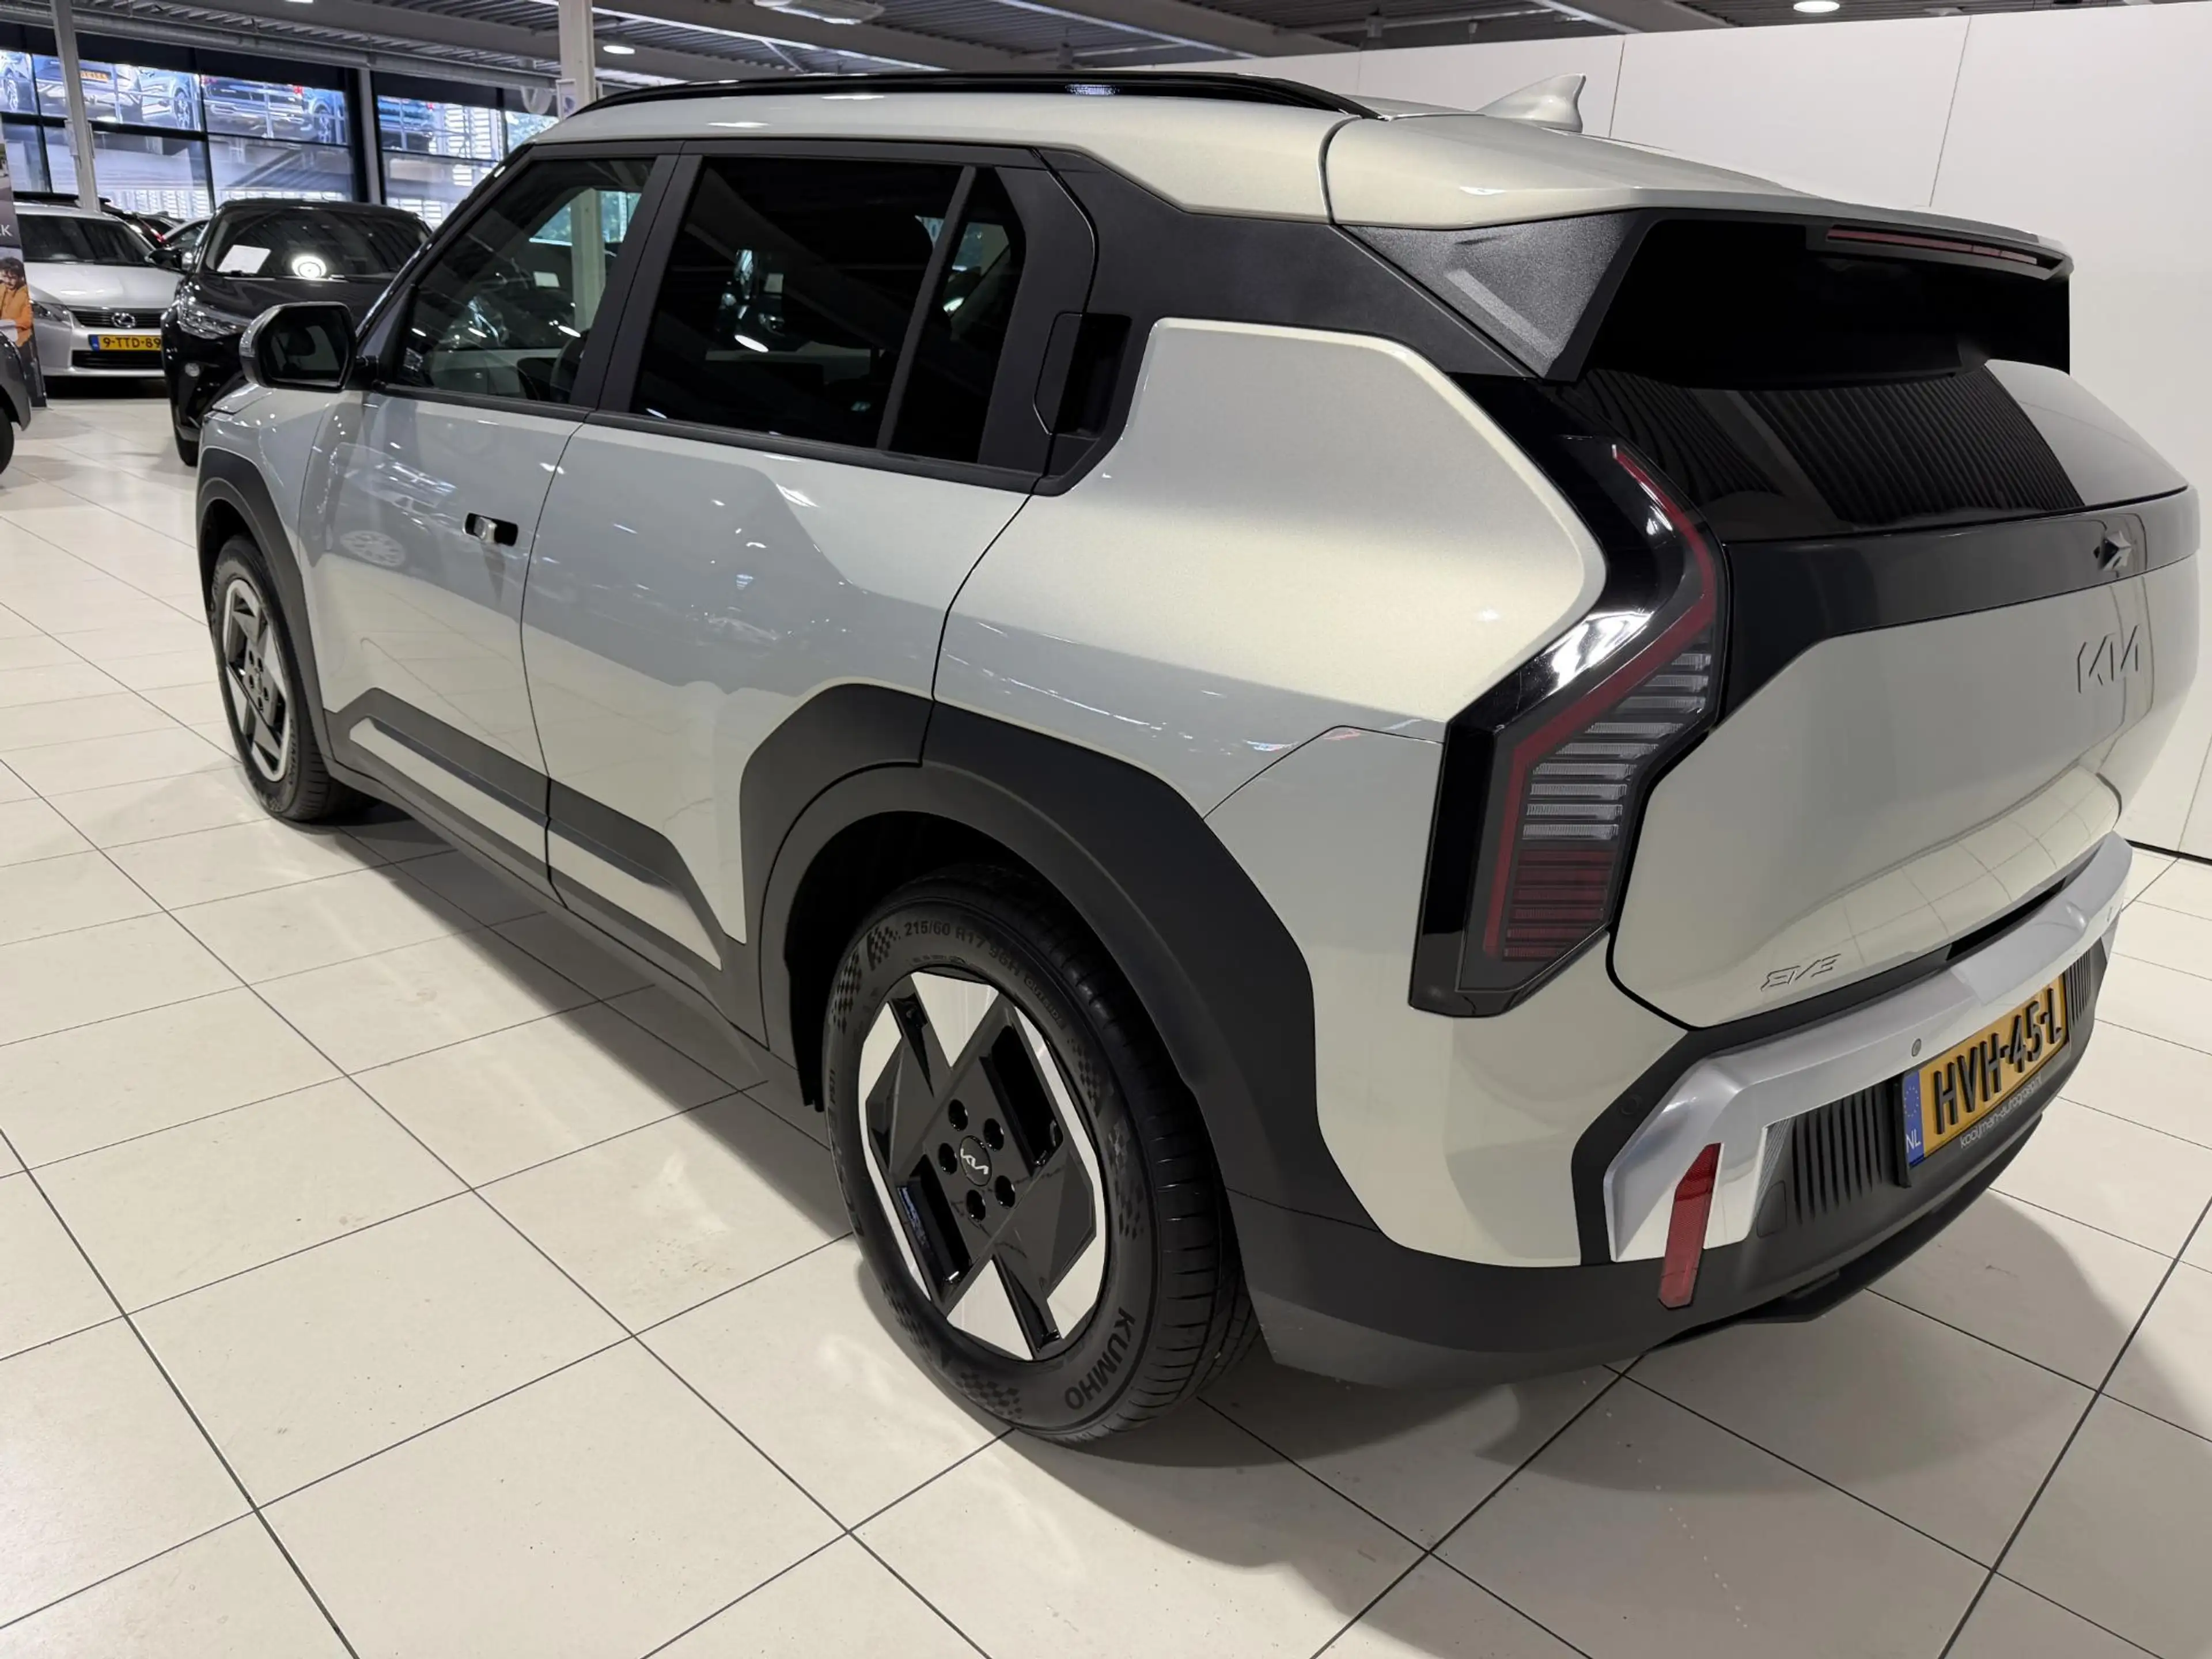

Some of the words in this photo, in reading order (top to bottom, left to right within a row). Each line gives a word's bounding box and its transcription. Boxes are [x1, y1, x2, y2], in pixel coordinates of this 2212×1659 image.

[2077, 623, 2140, 694] KIA
[903, 921, 950, 936] 215/60
[955, 926, 986, 948] R17
[1760, 953, 1841, 992] EV3
[1933, 987, 2062, 1135] HVH-45-L
[1905, 1128, 1922, 1153] NL
[1065, 1306, 1137, 1410] KUMHO
